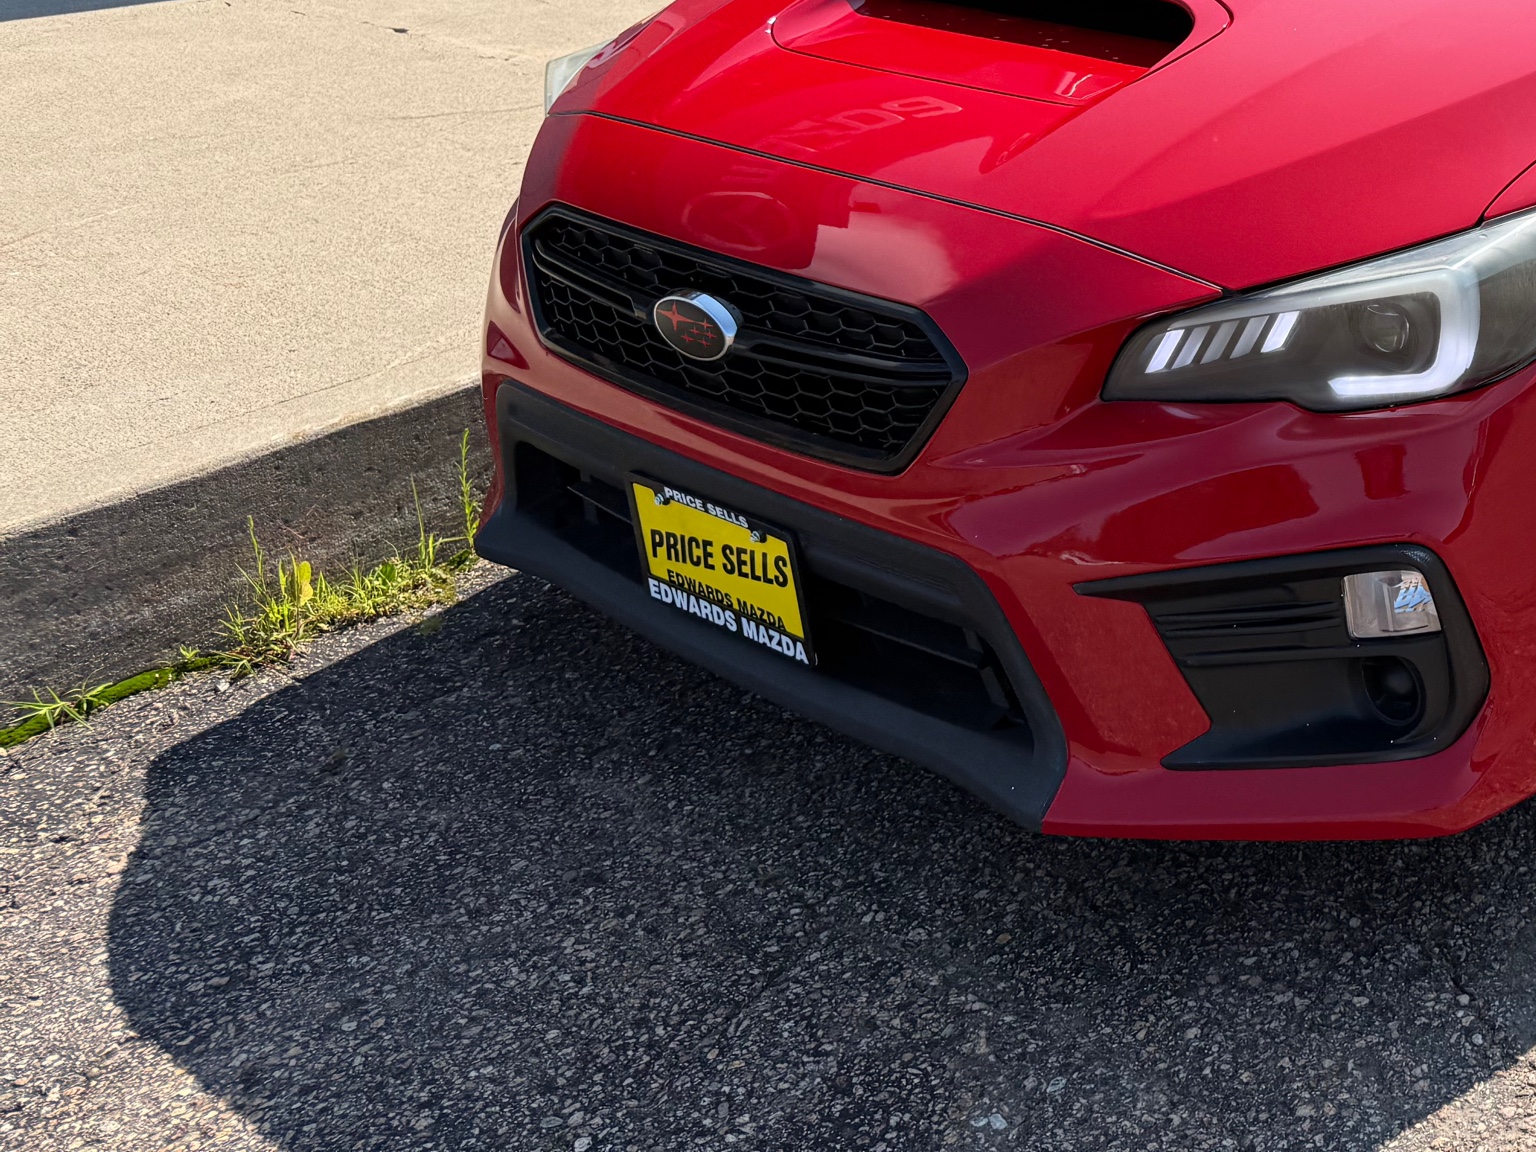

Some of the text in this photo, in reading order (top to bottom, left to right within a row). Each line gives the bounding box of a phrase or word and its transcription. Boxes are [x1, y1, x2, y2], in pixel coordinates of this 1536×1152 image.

[664, 486, 748, 528] PRICE SELLS
[650, 529, 788, 588] PRICE SELLS
[648, 578, 809, 665] EDWARDS MAZDA
[667, 569, 787, 632] EDWARDS MAZDA
